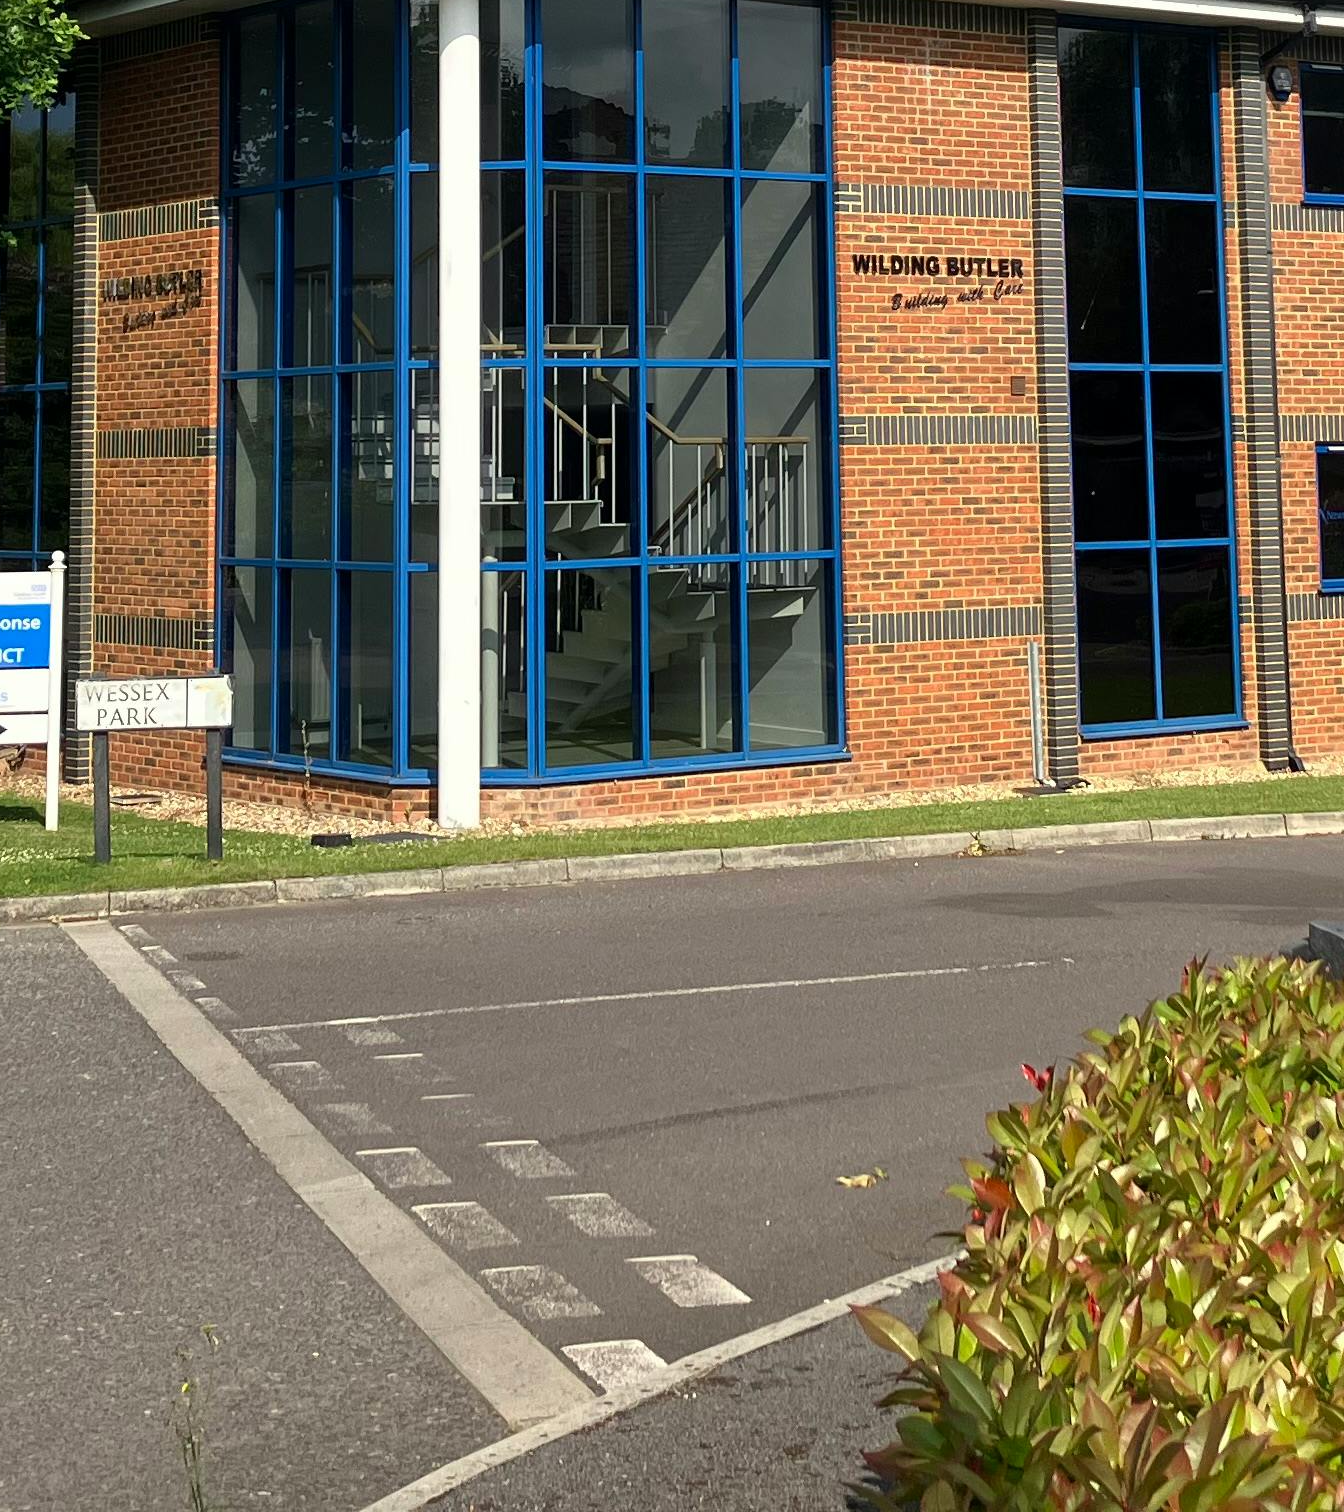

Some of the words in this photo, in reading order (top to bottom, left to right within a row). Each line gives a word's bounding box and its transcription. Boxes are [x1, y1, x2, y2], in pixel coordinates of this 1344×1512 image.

[852, 254, 940, 276] WILDING
[946, 257, 1024, 278] BUTLER
[84, 683, 170, 703] WESSEX
[97, 707, 158, 726] PARK
